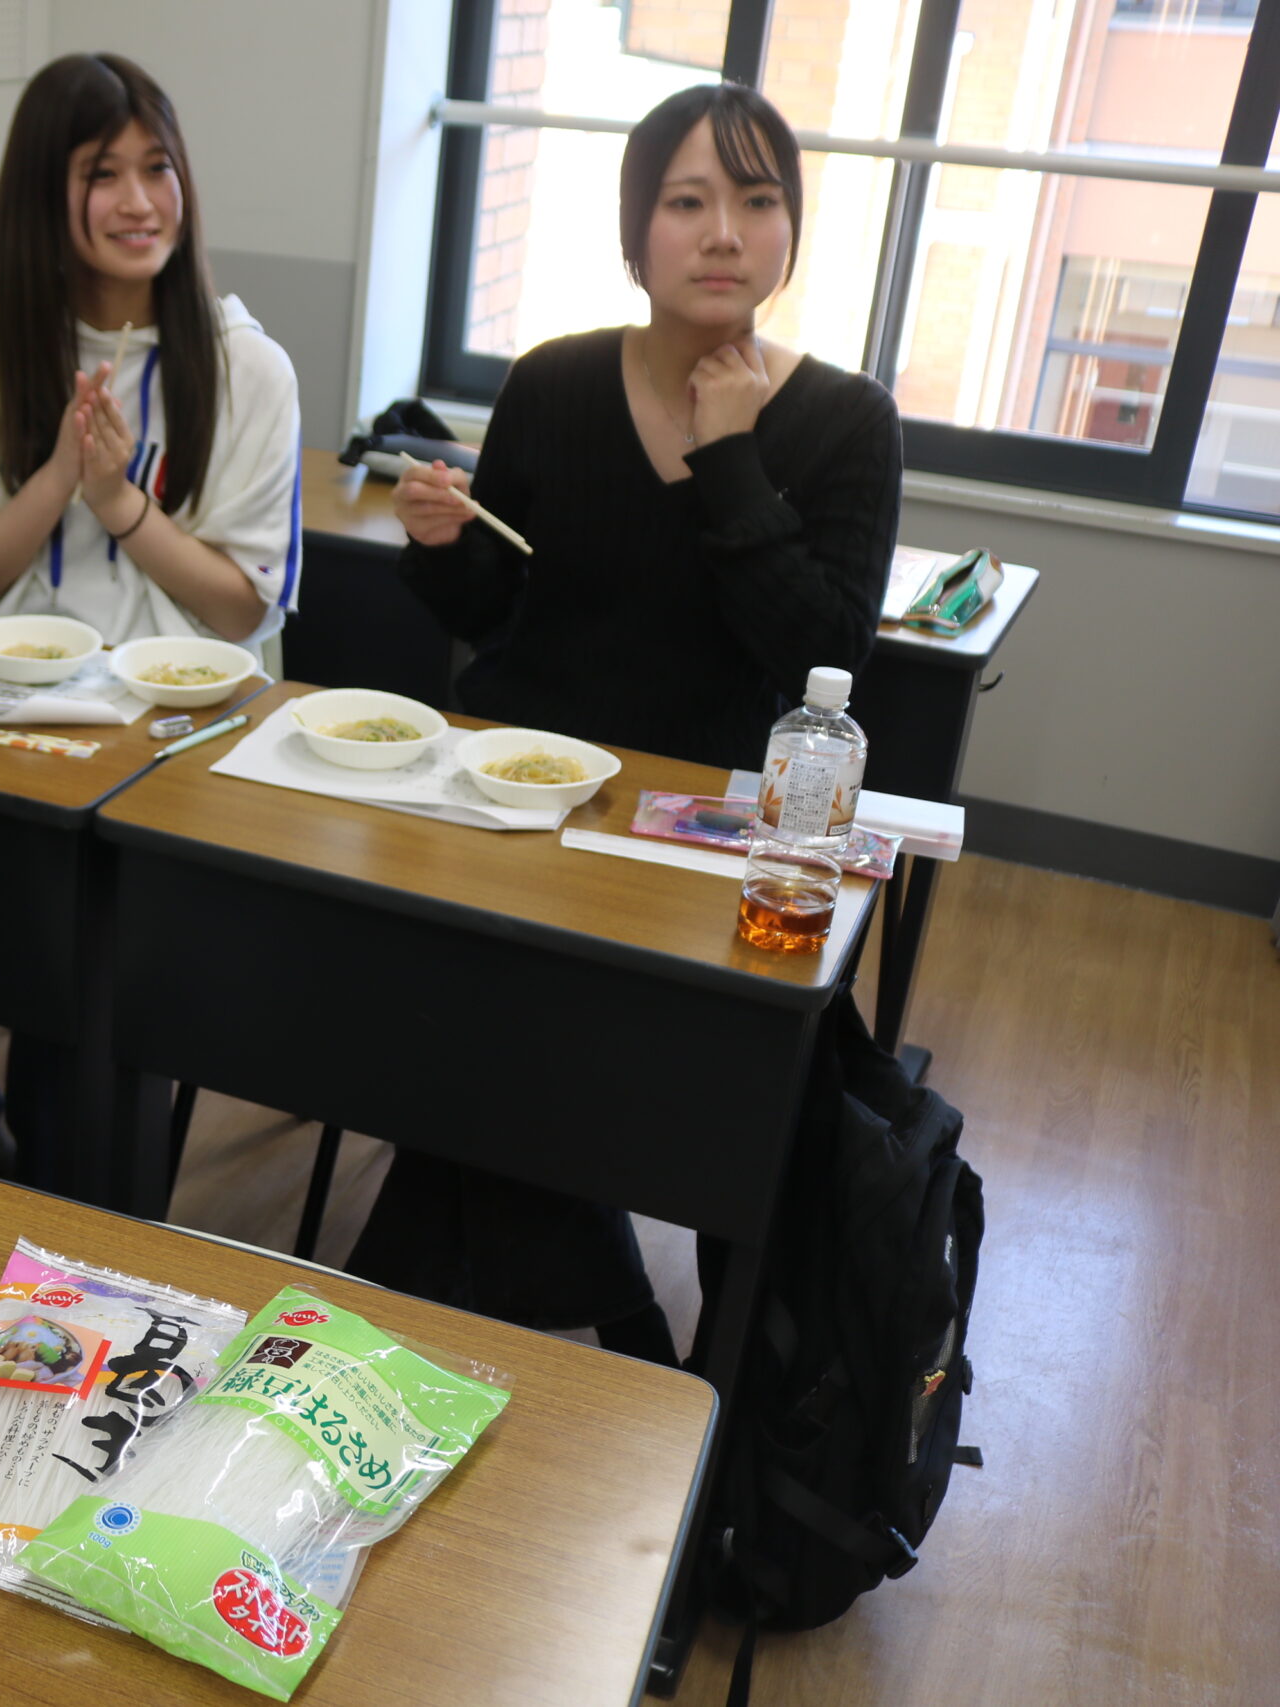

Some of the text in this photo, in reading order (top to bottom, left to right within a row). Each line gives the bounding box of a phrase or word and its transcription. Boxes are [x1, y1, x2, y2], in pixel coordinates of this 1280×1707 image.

[222, 1366, 393, 1490] 緑豆はるさめ
[88, 1532, 112, 1548] 100g
